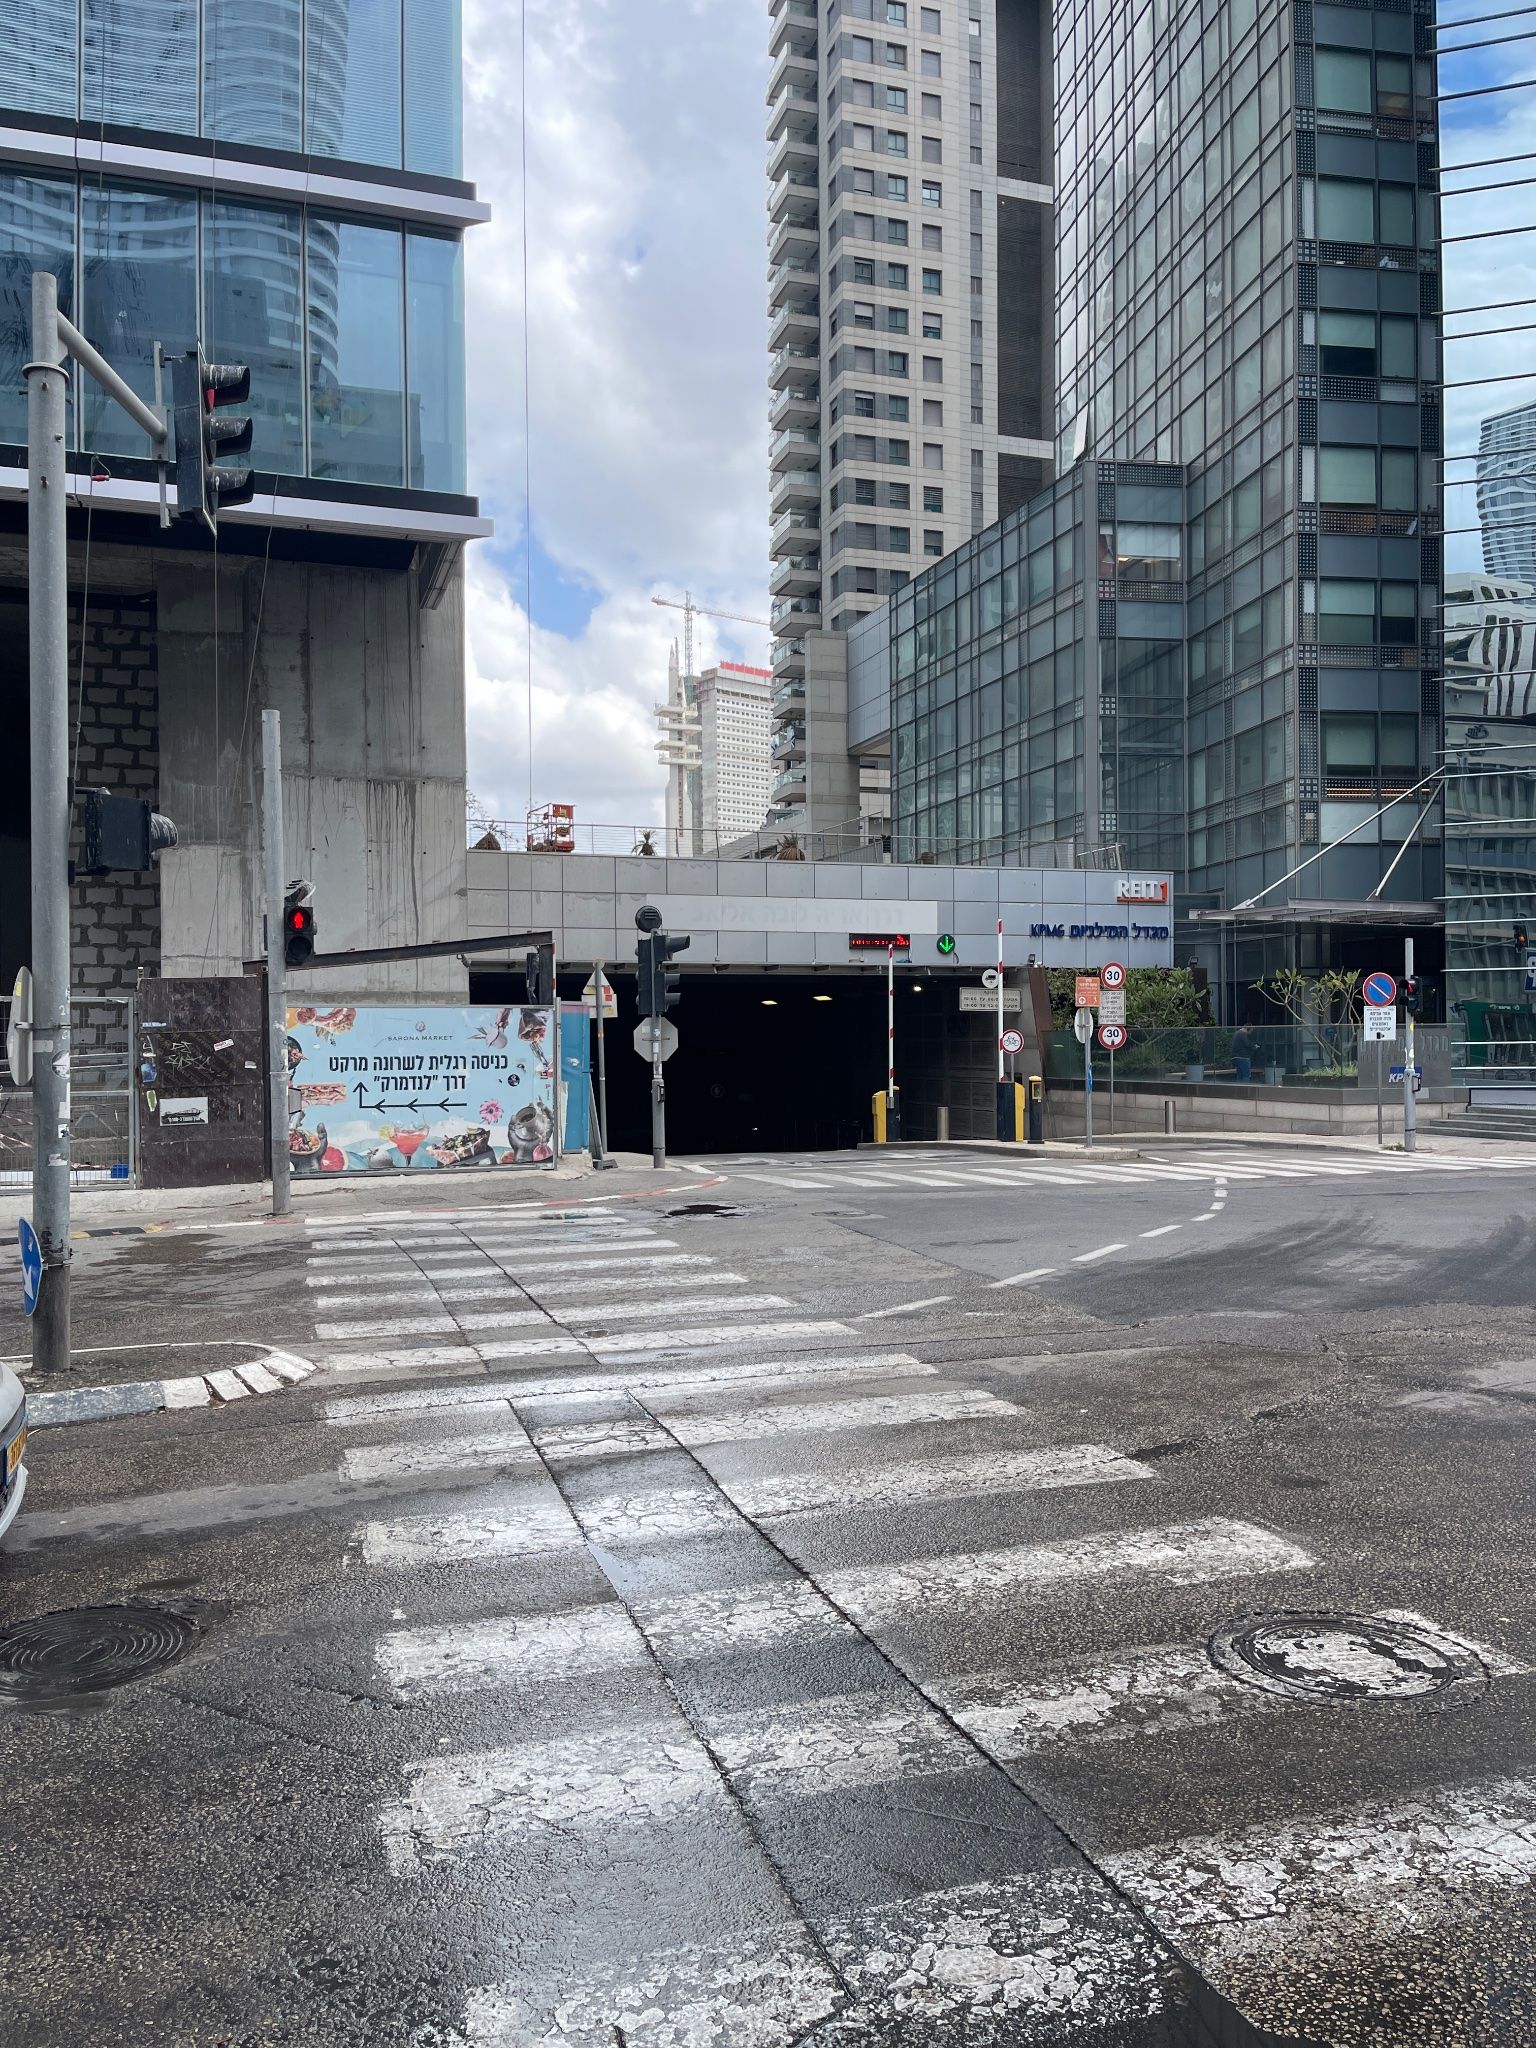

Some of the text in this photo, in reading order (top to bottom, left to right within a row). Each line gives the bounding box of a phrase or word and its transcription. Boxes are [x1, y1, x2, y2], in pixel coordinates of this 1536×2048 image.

[1030, 922, 1169, 939] מגדל המילניום KPMG
[1106, 971, 1120, 980] 30
[1106, 1029, 1119, 1038] 30
[329, 1054, 508, 1073] כניסה רגלית לשרונה מרקט
[442, 1074, 466, 1091] דרך
